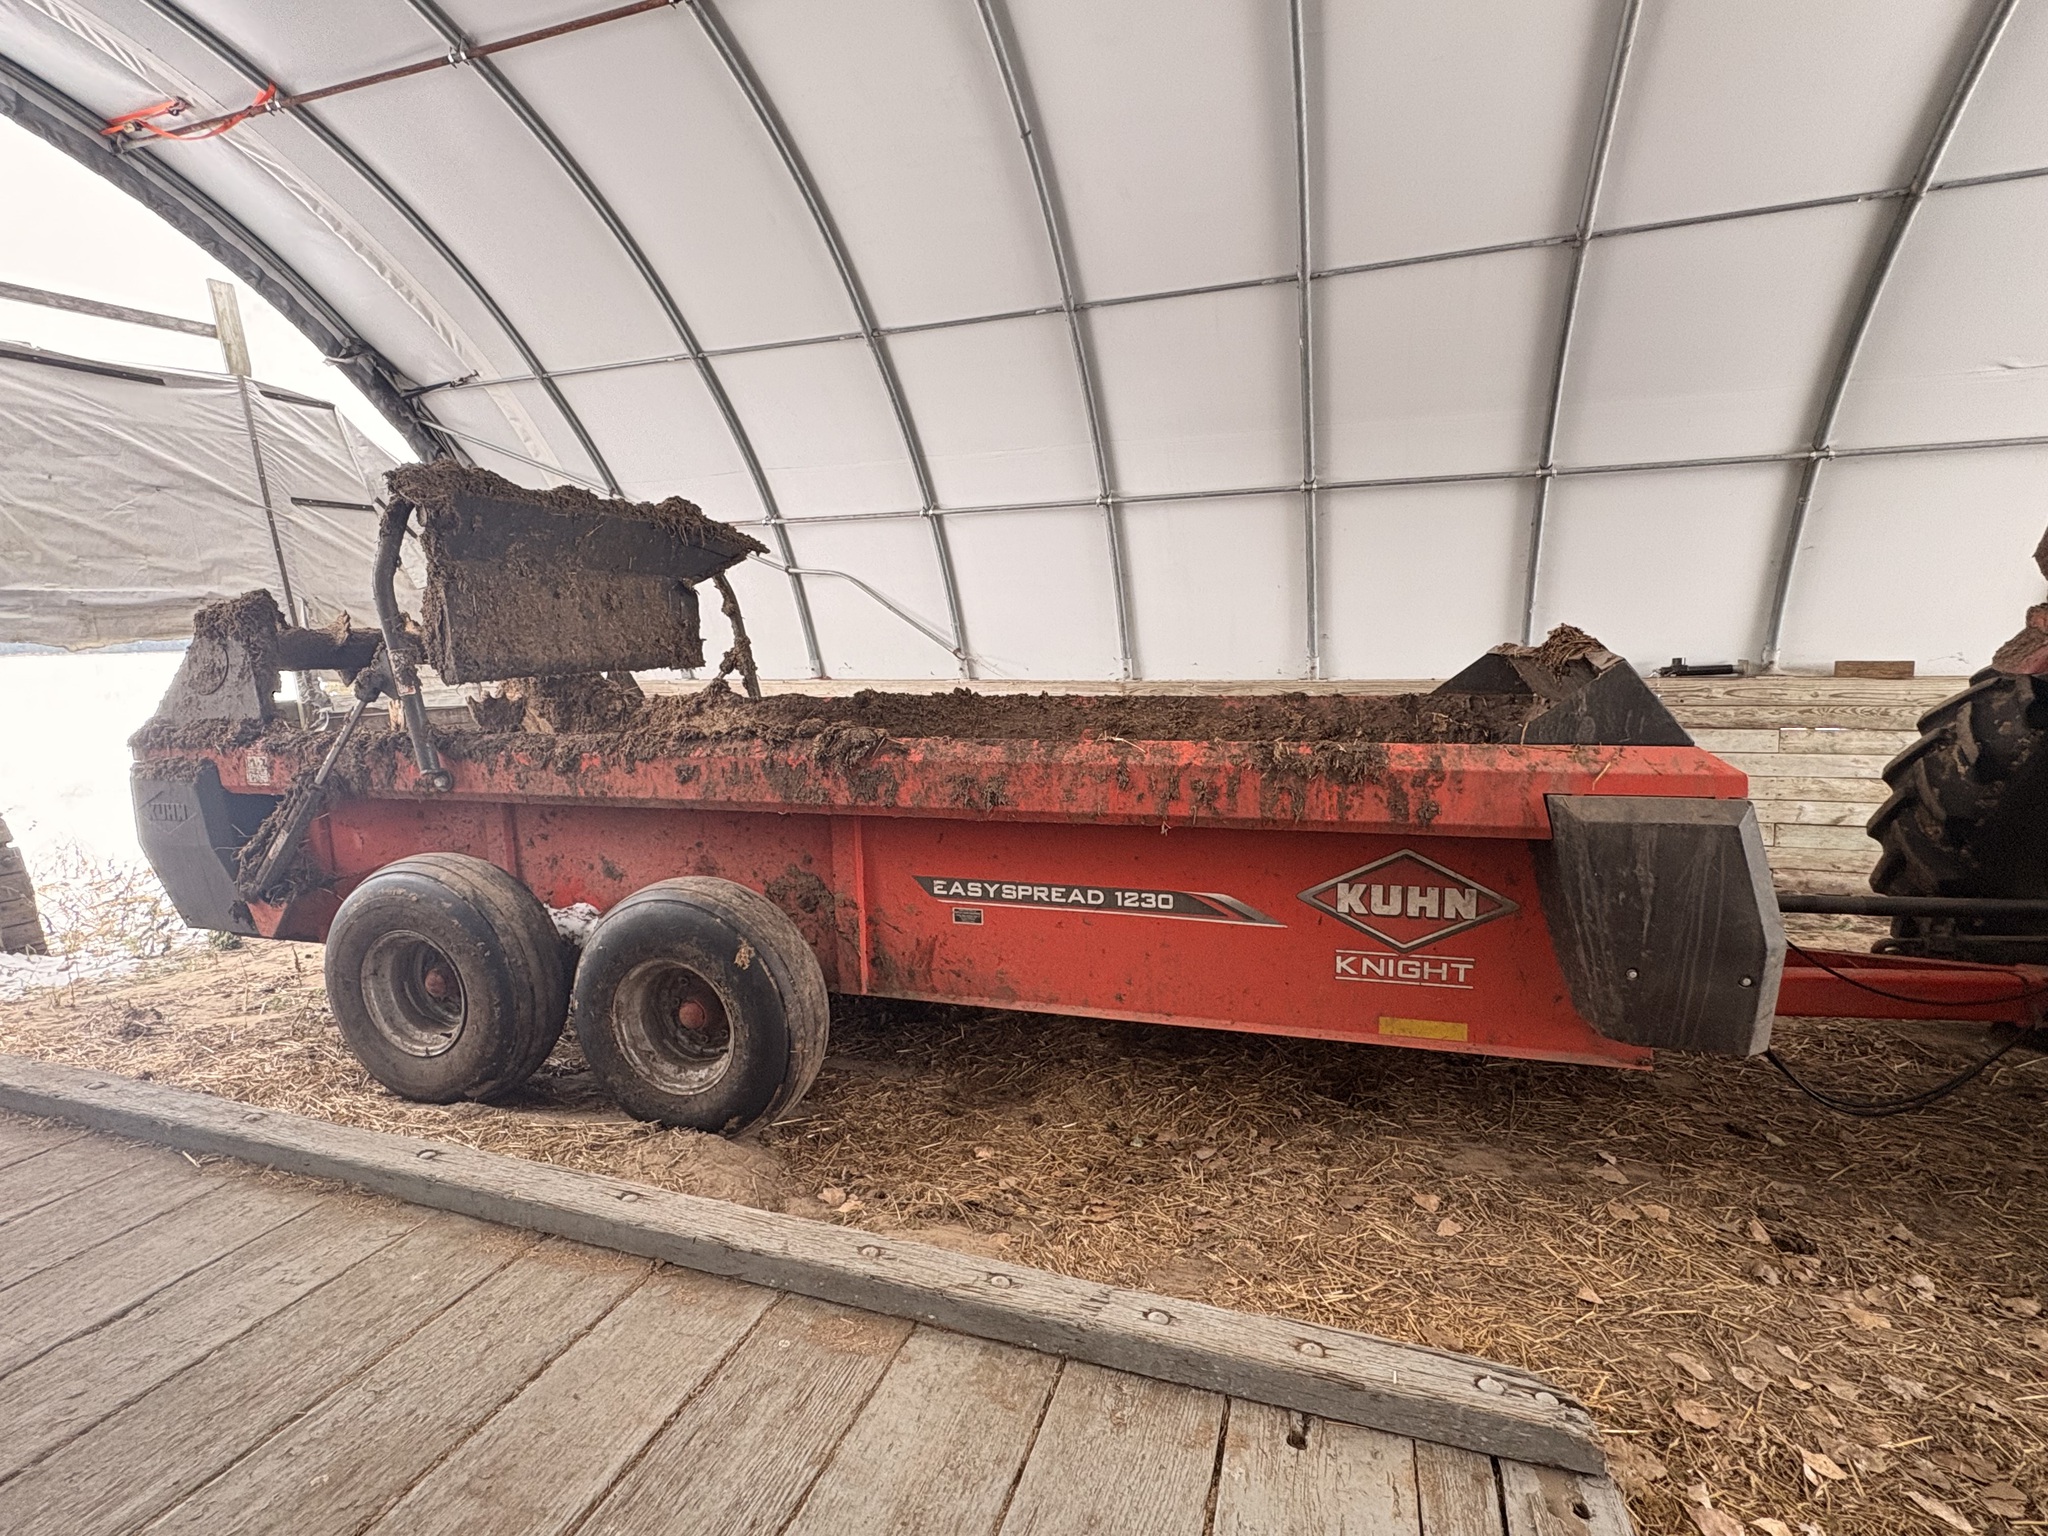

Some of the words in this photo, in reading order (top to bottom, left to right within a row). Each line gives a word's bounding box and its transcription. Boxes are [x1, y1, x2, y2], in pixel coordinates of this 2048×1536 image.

[148, 803, 188, 821] KUHN
[933, 880, 1104, 905] EASYSPREAD
[1115, 891, 1174, 910] 1230
[1336, 882, 1478, 920] KUHN
[1335, 955, 1474, 983] KNIGHT
